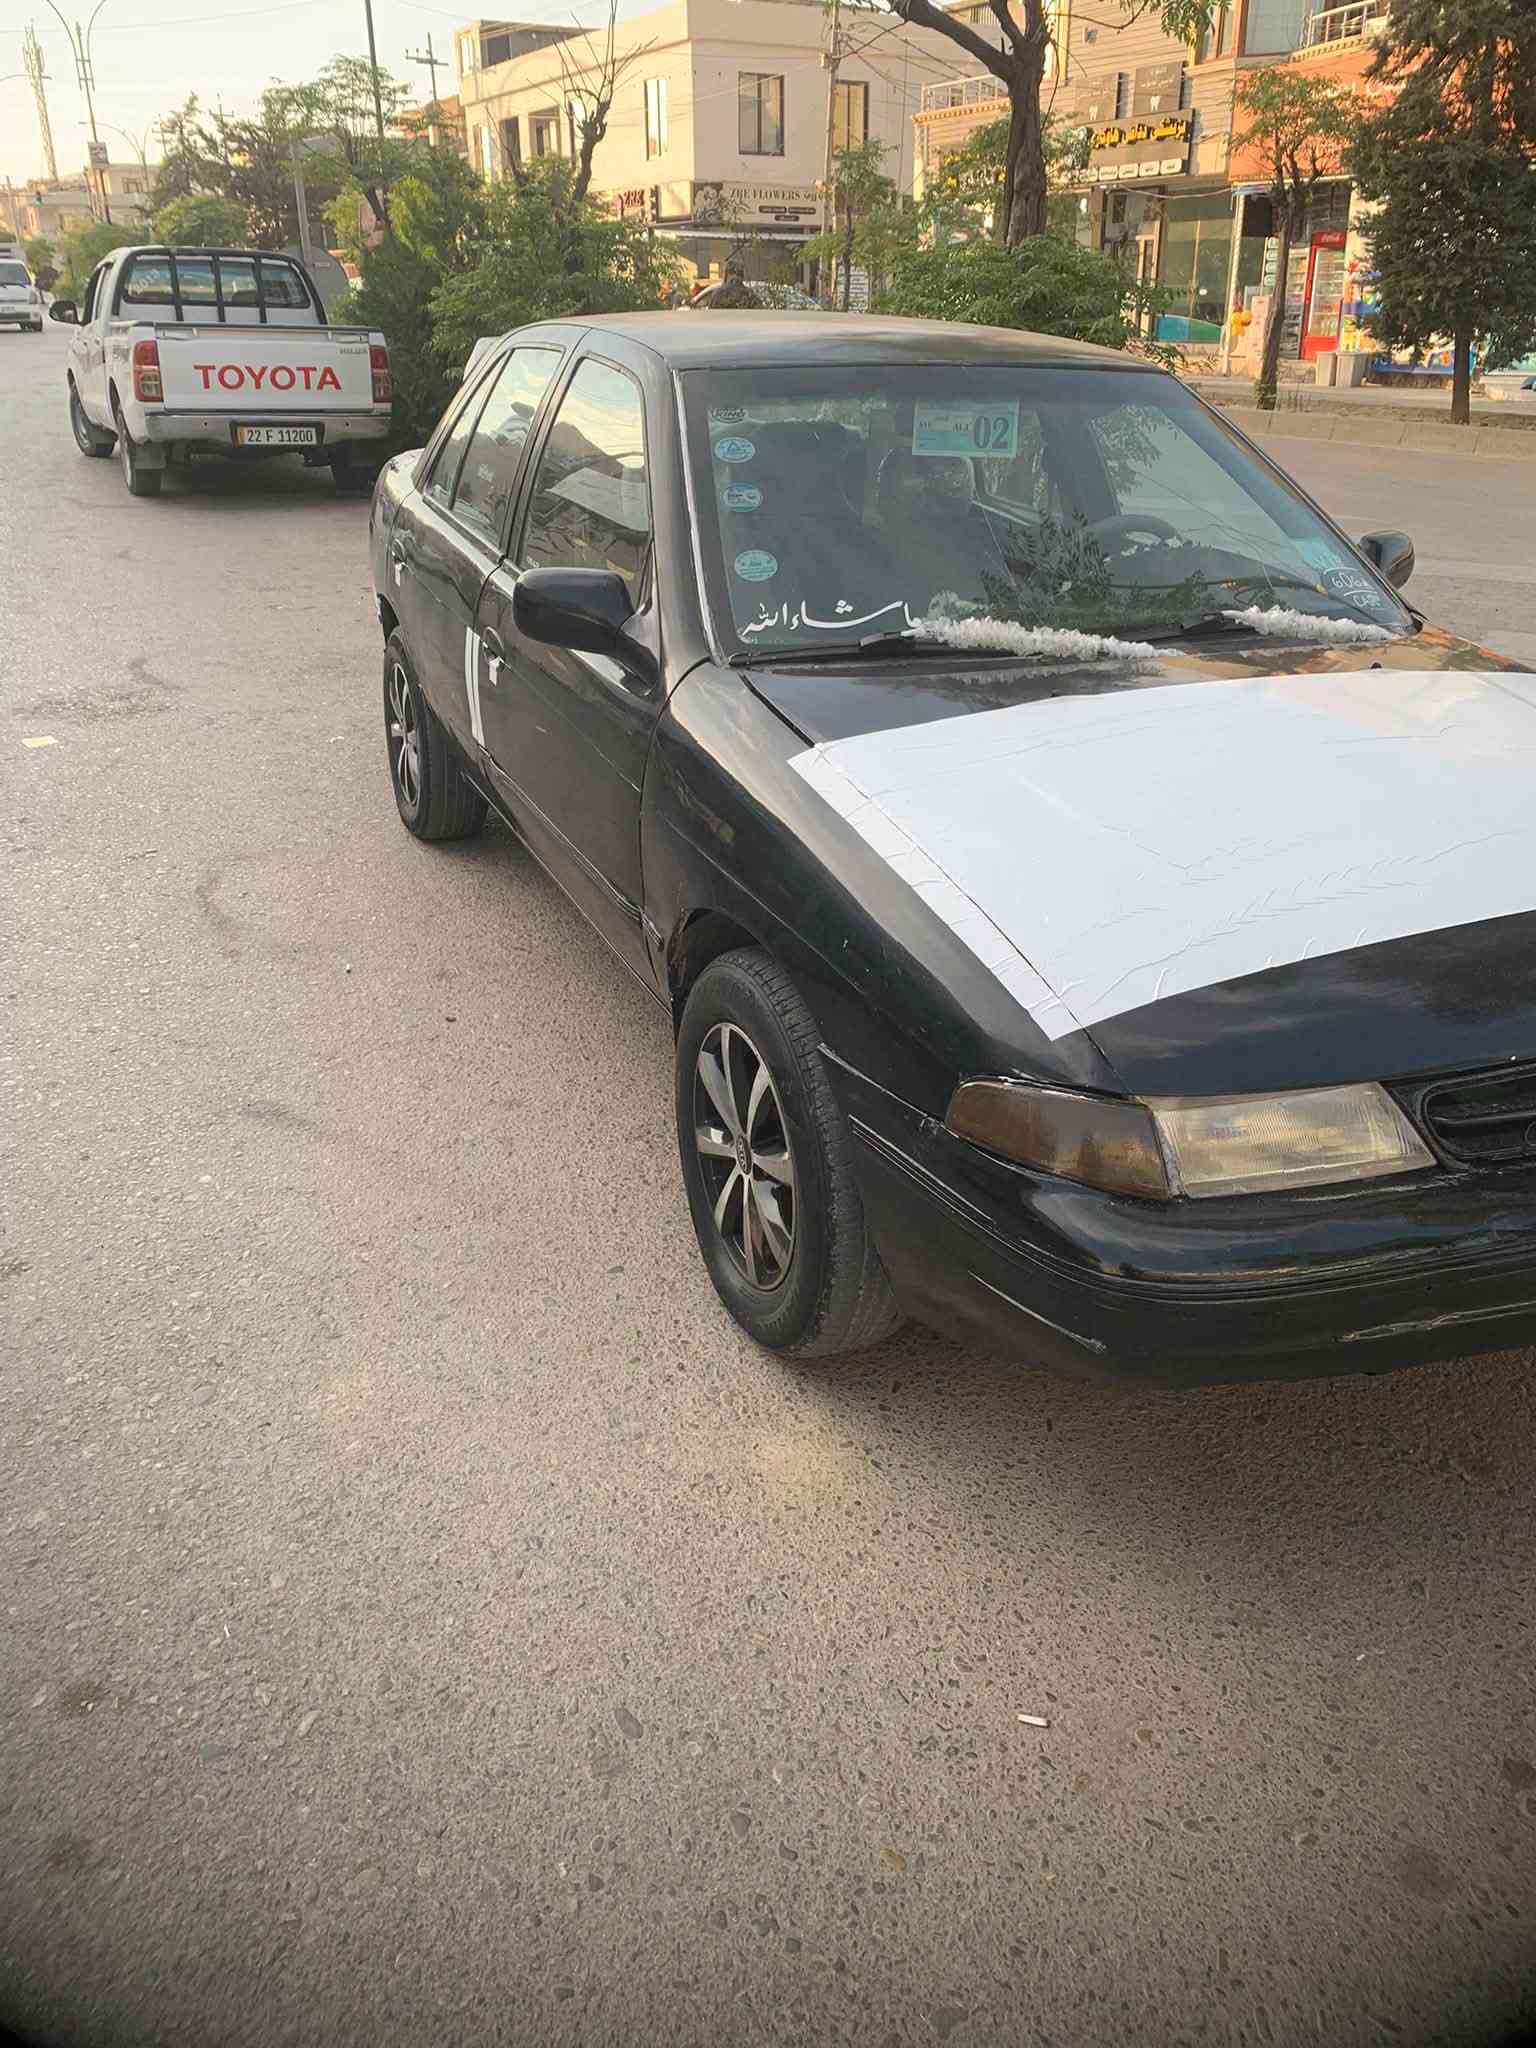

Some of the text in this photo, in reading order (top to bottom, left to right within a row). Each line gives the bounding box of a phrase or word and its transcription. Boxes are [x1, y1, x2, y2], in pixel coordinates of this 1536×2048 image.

[193, 364, 342, 391] TOYOTA
[247, 430, 314, 443] 22 F 11200
[974, 415, 1009, 449] 02
